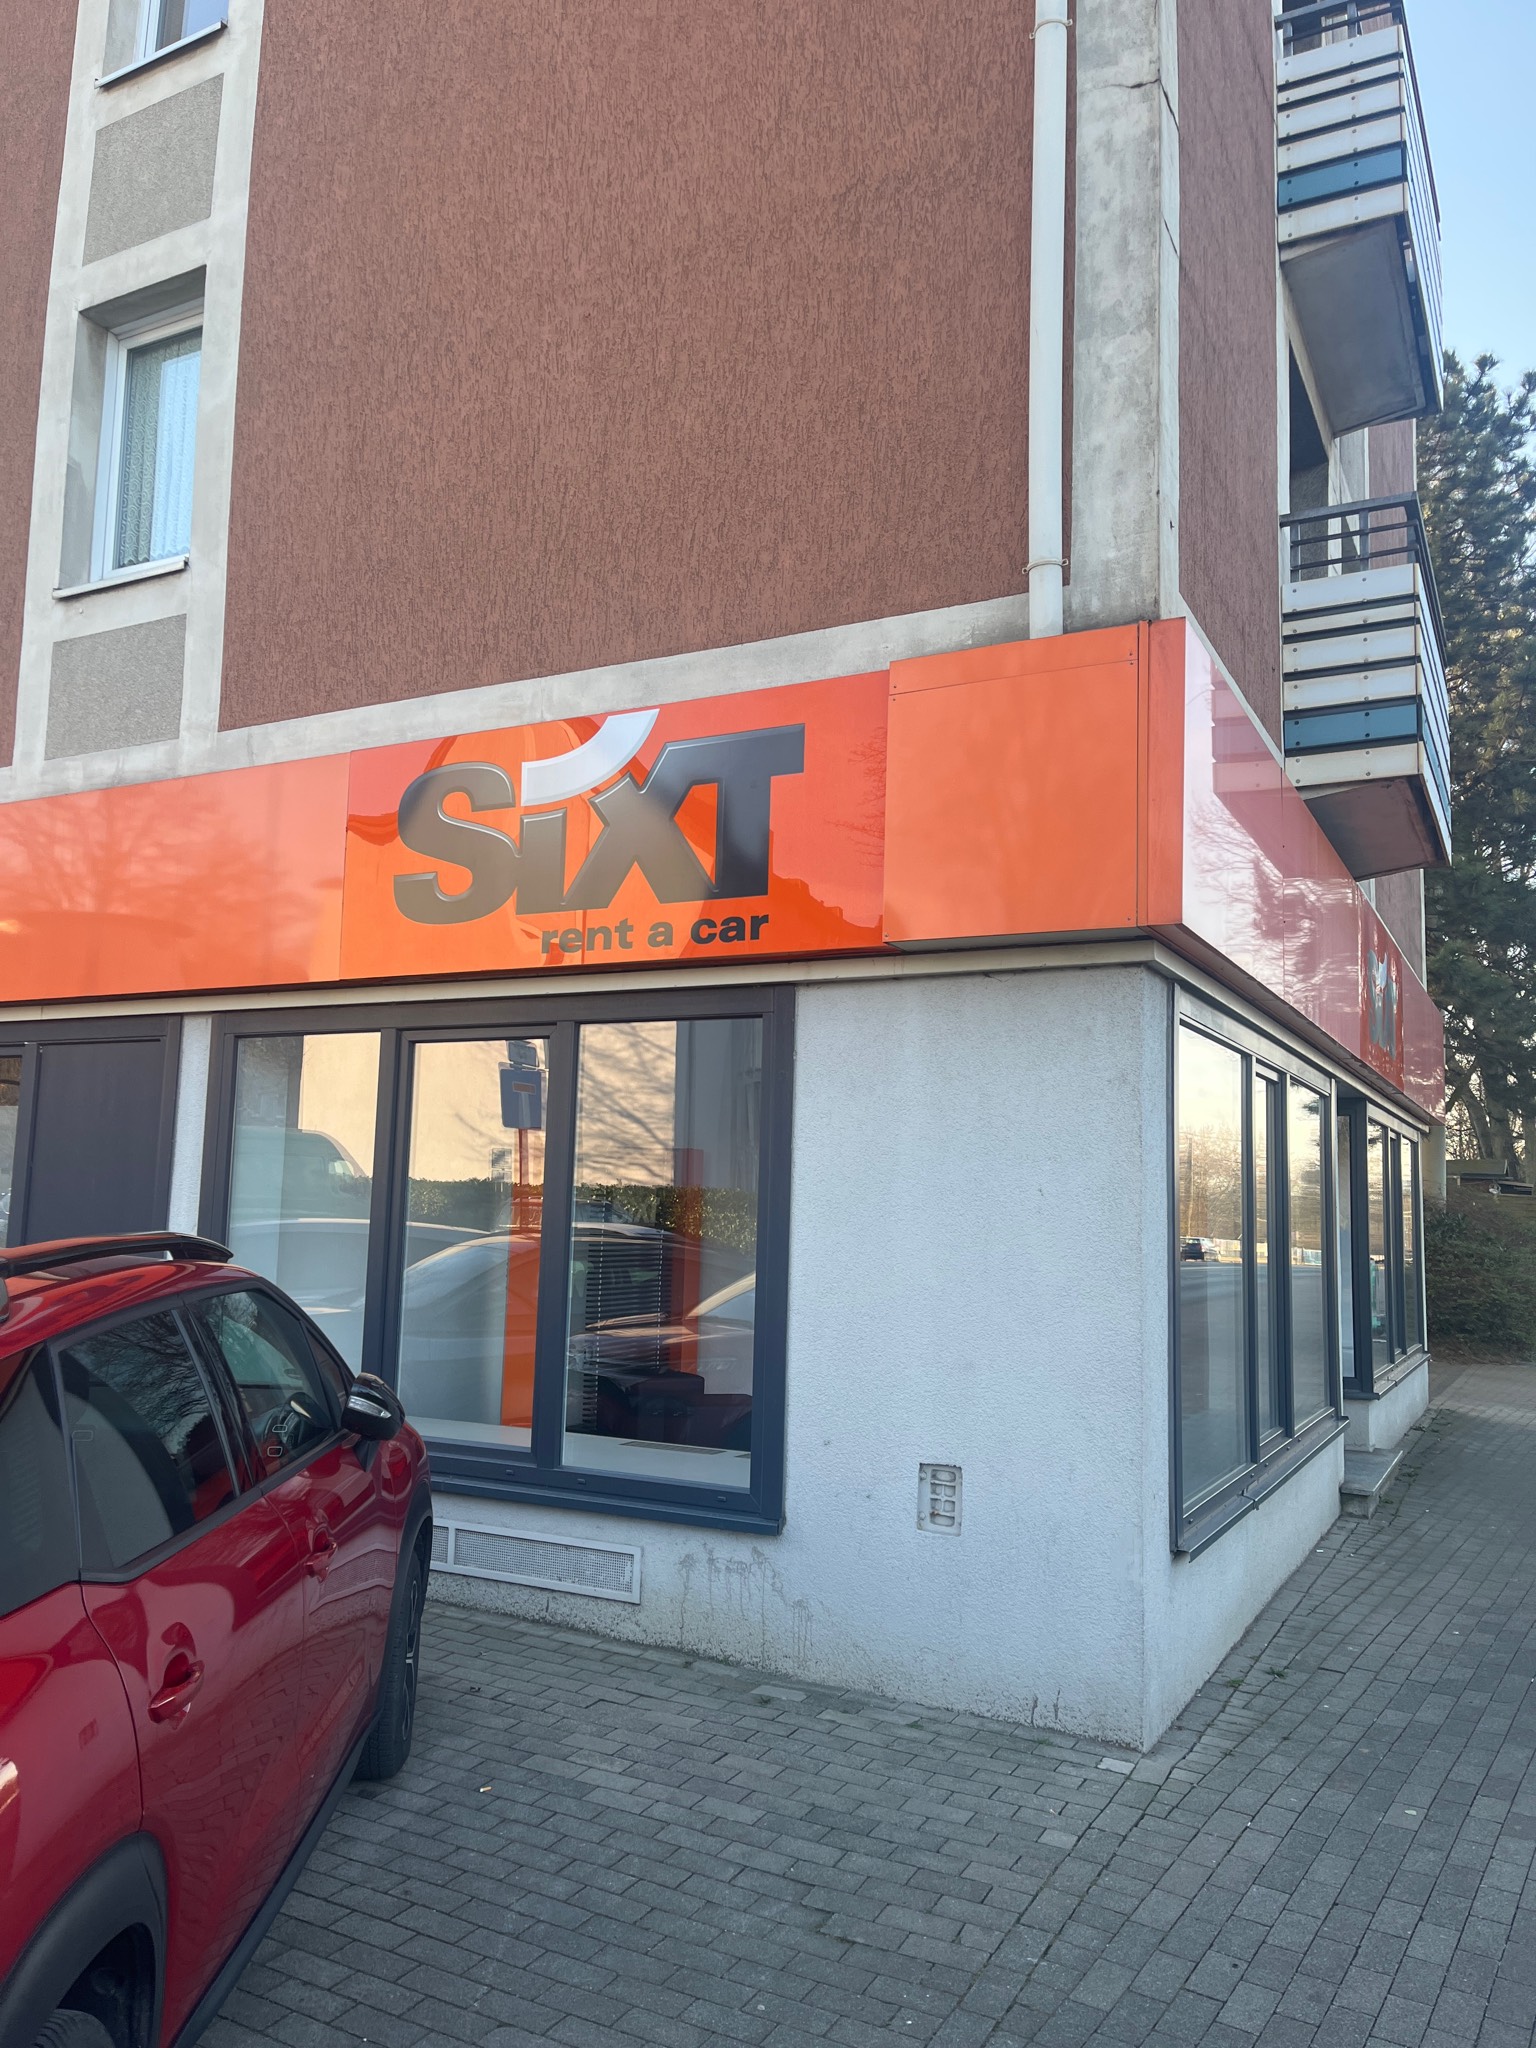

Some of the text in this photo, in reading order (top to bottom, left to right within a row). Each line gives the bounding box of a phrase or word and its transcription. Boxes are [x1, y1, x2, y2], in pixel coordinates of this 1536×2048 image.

[541, 914, 769, 954] rent a car
